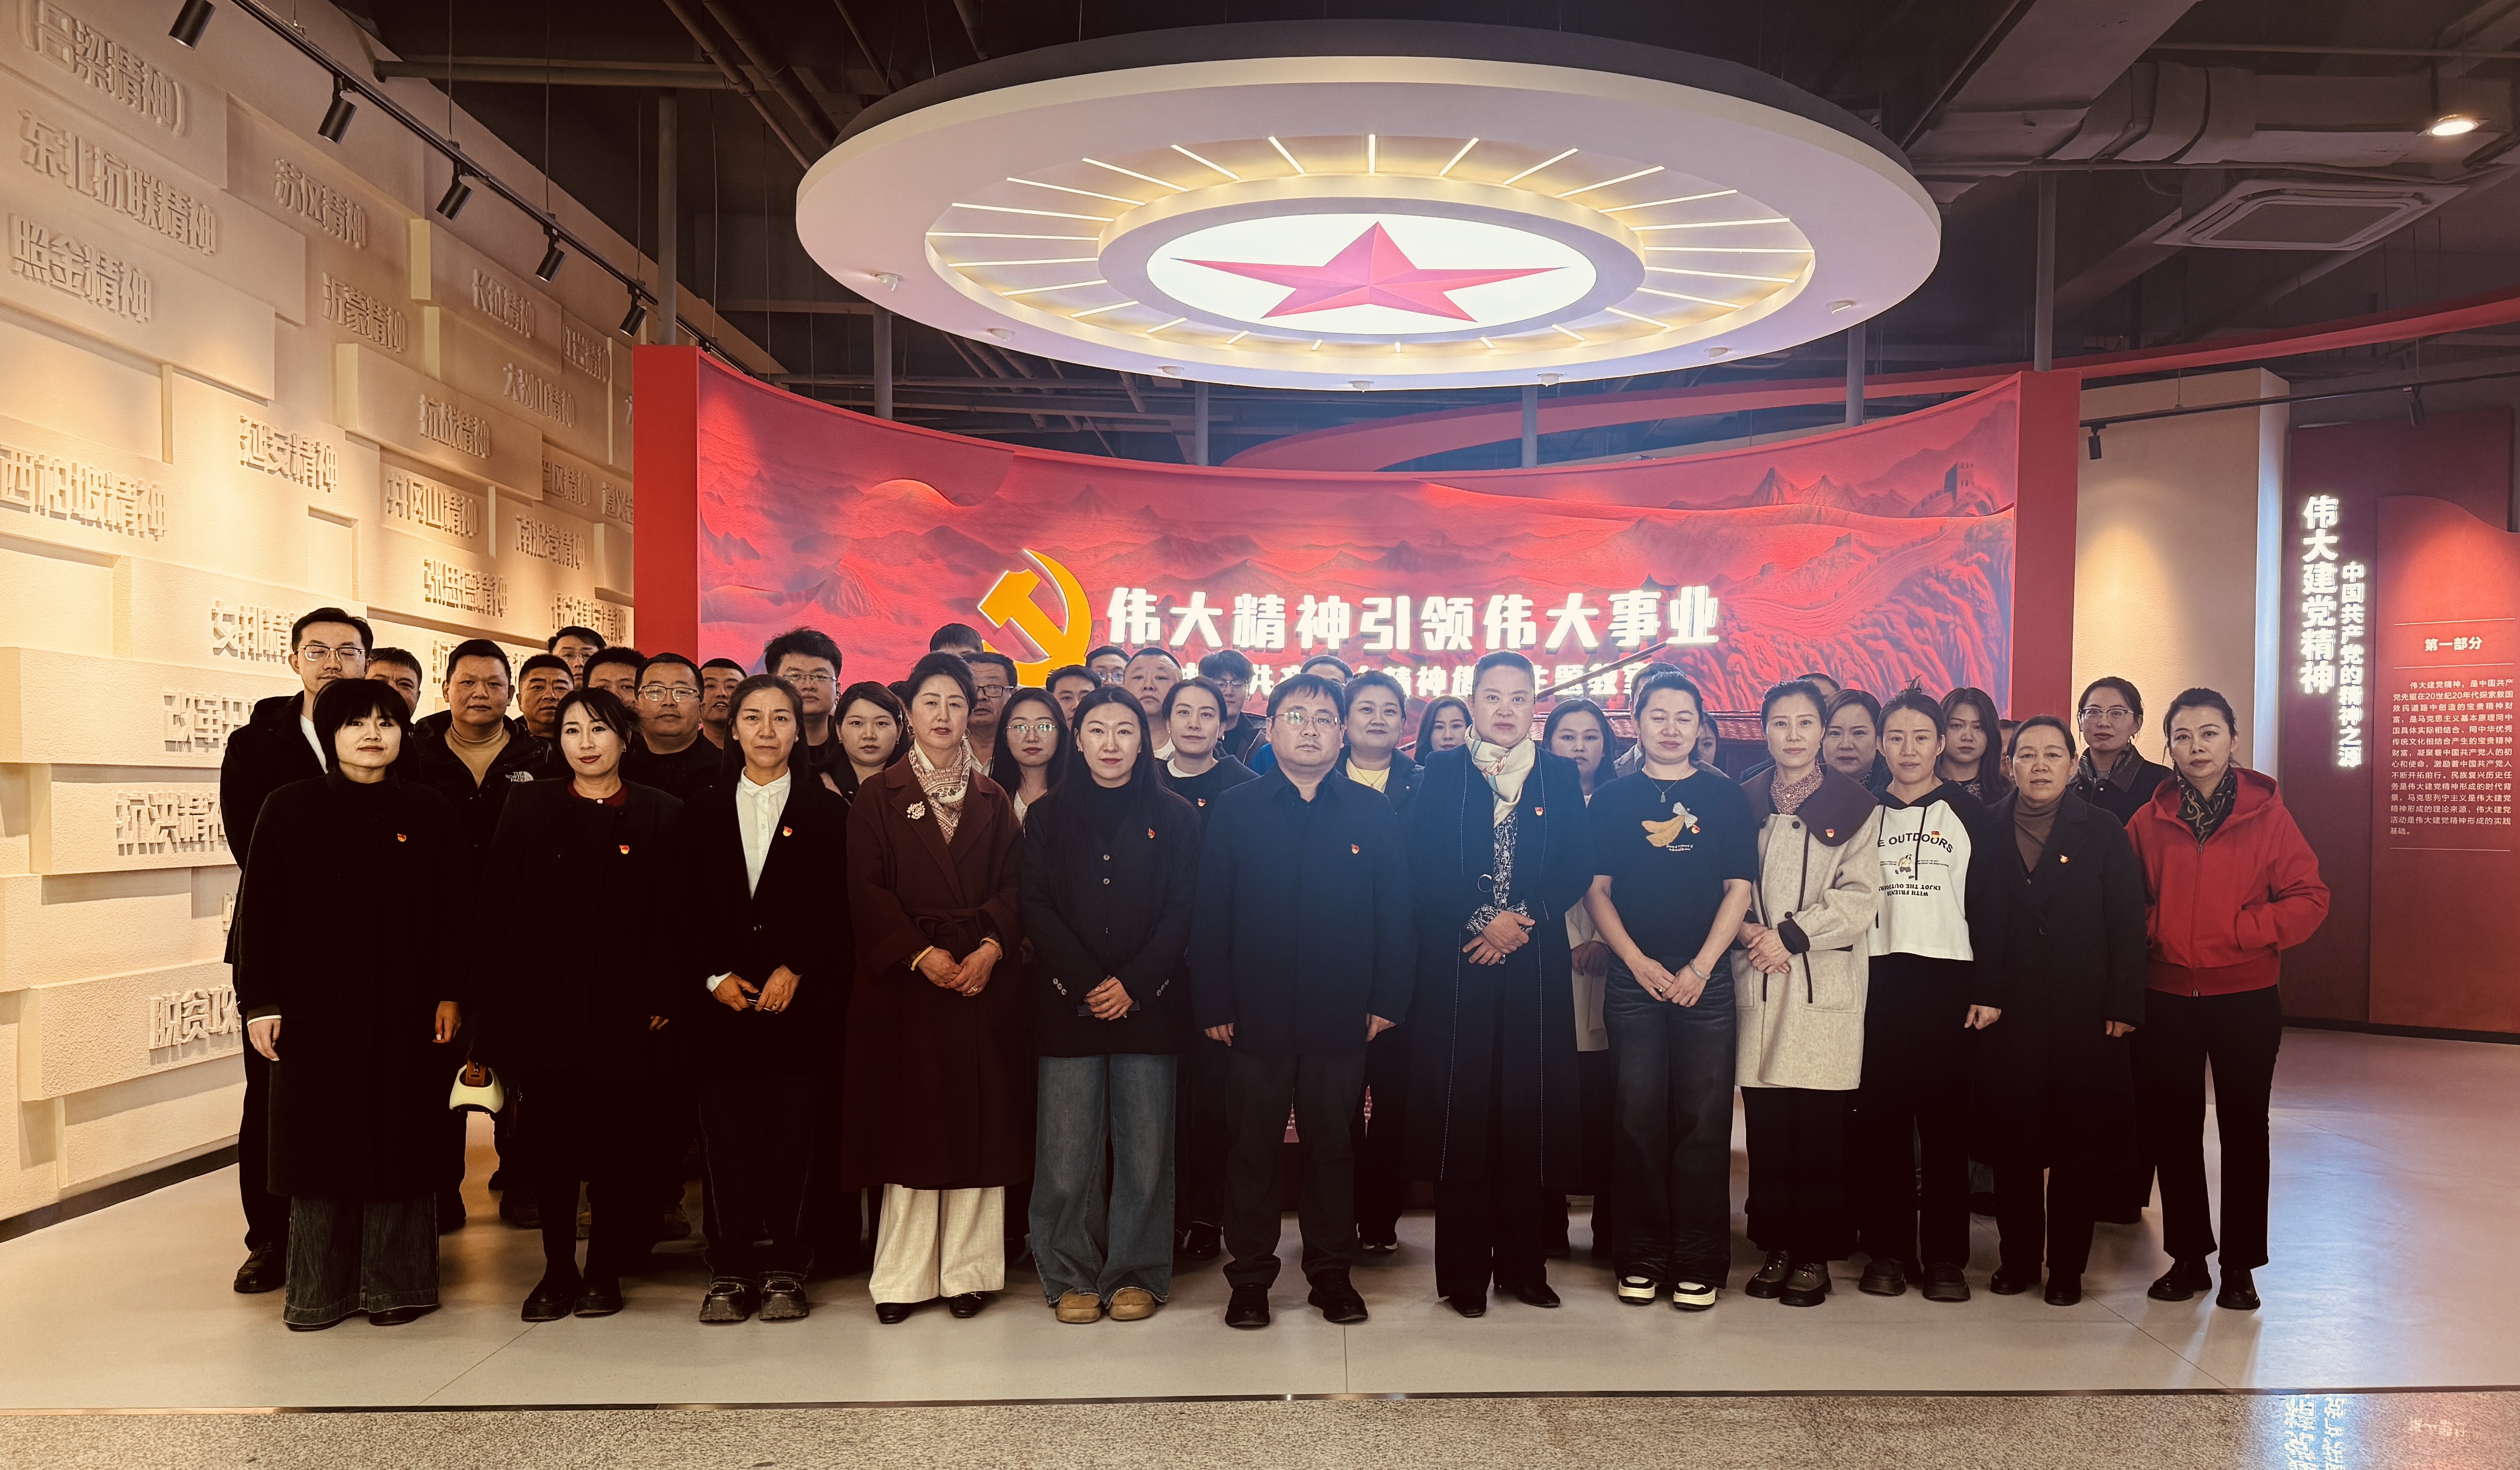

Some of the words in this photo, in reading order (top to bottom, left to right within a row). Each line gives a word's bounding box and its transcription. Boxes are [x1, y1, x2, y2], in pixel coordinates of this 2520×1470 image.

[18, 109, 216, 255] 东北抗联精神
[9, 213, 152, 323] 照金精神
[321, 272, 406, 354] 沂蒙精神
[240, 414, 339, 492] 延安精神
[0, 444, 167, 541] 西柏坡精神
[387, 472, 478, 539] 井冈山精神
[516, 515, 585, 570] 南泥湾精神
[424, 558, 507, 617] 张思德精神
[1107, 585, 1719, 650] 伟大精神引领伟大事业
[2300, 494, 2339, 694] 伟大建党精神
[2338, 561, 2365, 767] 中国共产党的精神之源
[2424, 637, 2483, 652] 第一部分
[2410, 679, 2514, 690] 伟大建党精神，是中国共产
[2392, 736, 2513, 745] 传统文化相结合产生的宝贵精神
[1889, 832, 1953, 853] OUTDOORS
